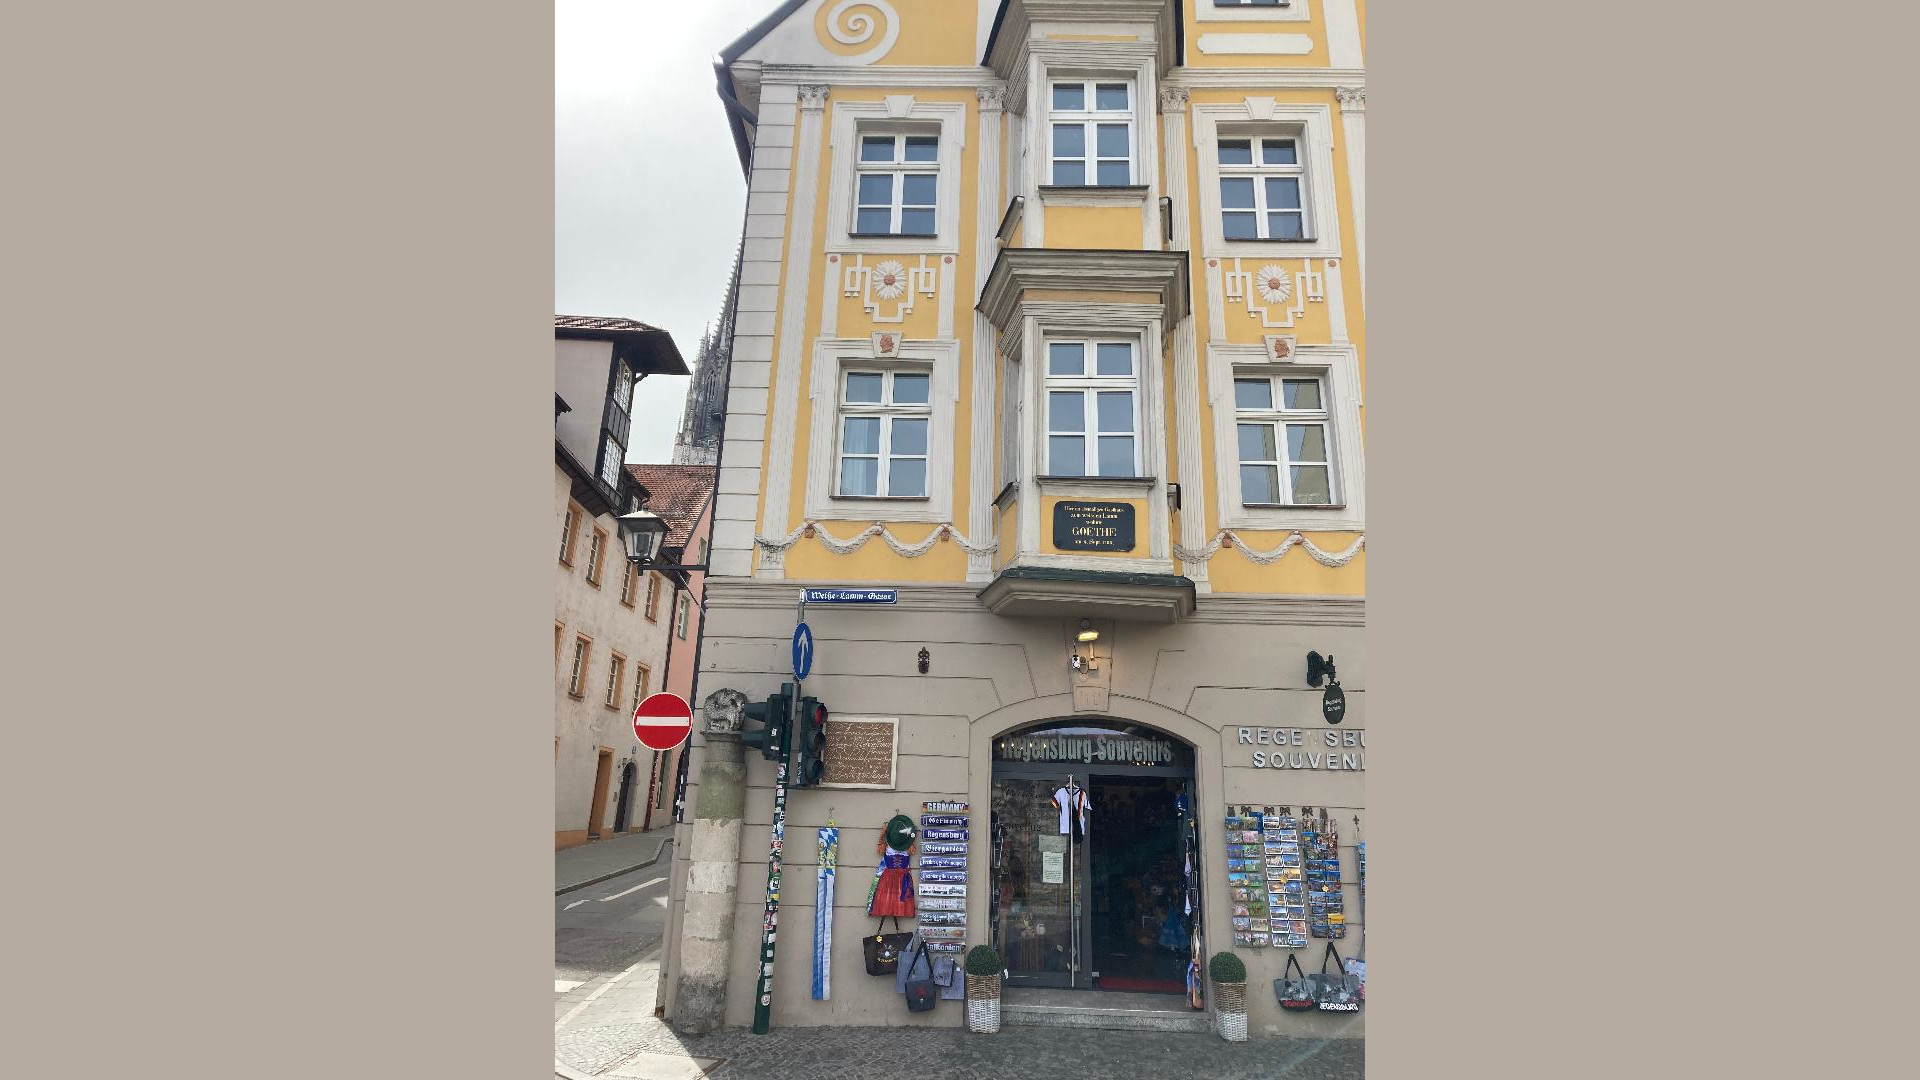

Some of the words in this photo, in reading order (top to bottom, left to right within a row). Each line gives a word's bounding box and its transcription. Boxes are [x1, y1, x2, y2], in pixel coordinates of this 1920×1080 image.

[1072, 526, 1117, 537] GOETHE
[1002, 735, 1093, 764] Regensburg
[1097, 736, 1172, 762] Souvenirs
[927, 802, 965, 812] GERMANY
[927, 830, 964, 840] Regensburg
